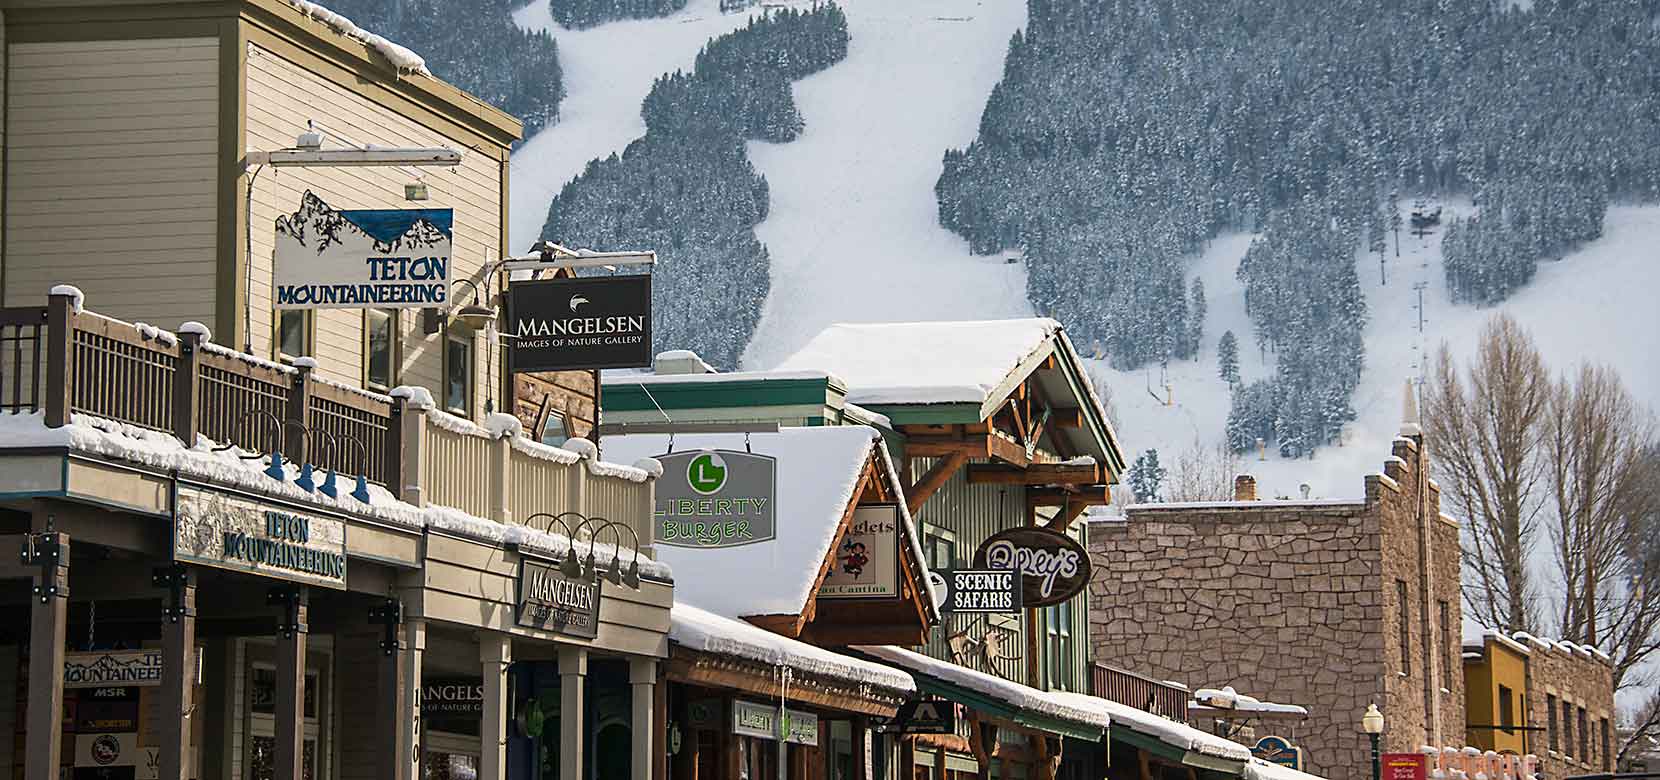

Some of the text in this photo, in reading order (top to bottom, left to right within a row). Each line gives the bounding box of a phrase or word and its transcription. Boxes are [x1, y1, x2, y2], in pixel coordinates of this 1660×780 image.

[366, 256, 447, 281] TETON
[277, 284, 446, 305] MOUNTAINEERING
[517, 315, 644, 337] MANGELSEN
[517, 335, 642, 348] IMAGES OF NATURE GALLERY
[264, 510, 310, 544] TETON
[852, 520, 895, 536] glets
[223, 531, 344, 579] MOUNTAINEERING
[530, 569, 594, 610] MANGELSEN
[955, 573, 1012, 590] SCENIC
[955, 591, 1012, 608] SAFARIS
[94, 688, 127, 697] MSR
[420, 685, 484, 700] ANGELS
